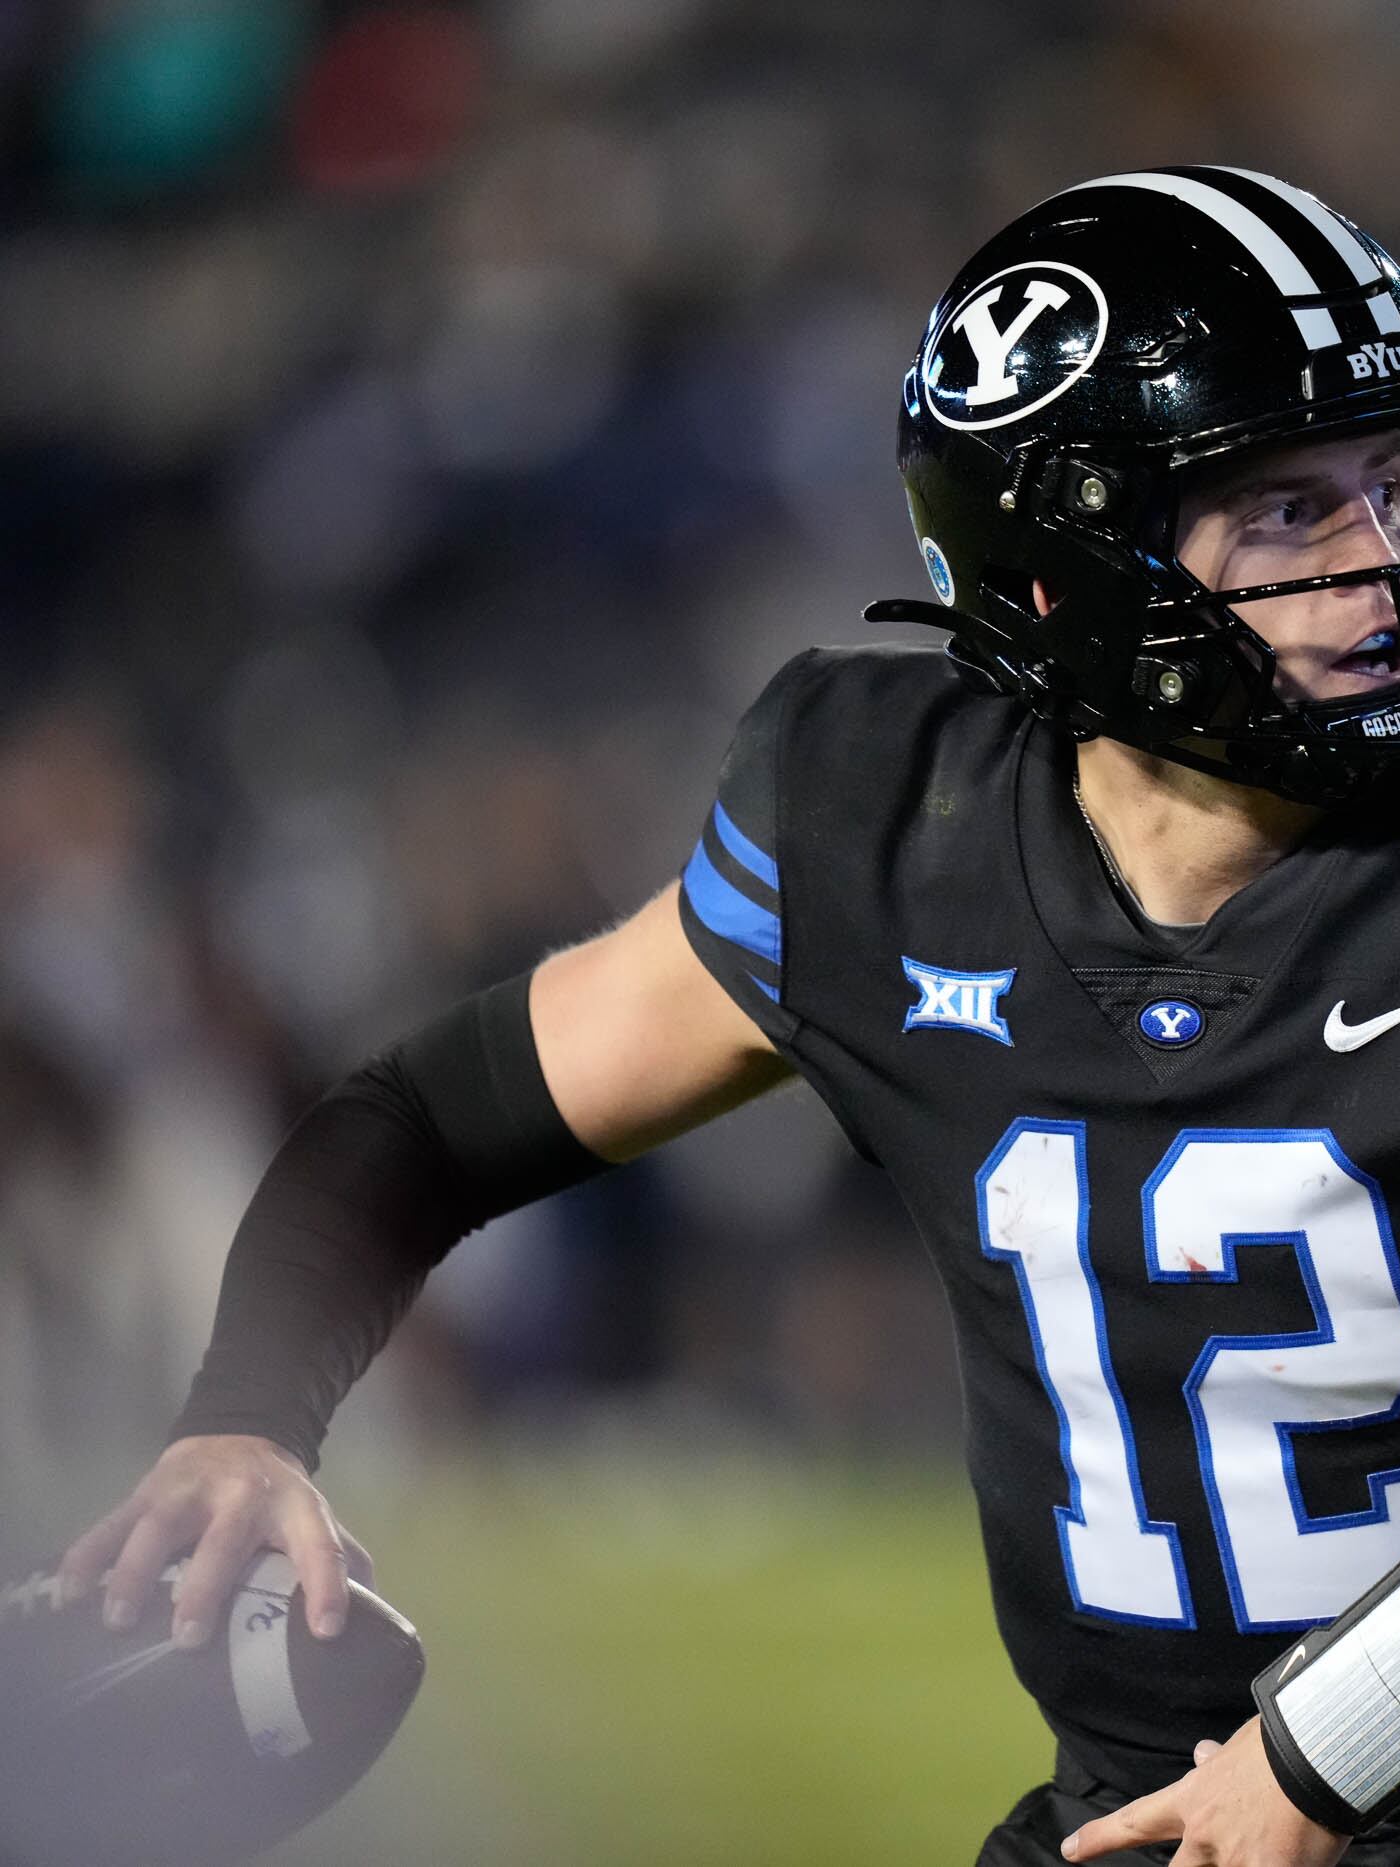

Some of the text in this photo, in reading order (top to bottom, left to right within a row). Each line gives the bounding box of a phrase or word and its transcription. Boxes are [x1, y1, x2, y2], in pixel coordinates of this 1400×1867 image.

[952, 280, 1071, 406] Y
[1361, 716, 1387, 737] GO
[908, 965, 1008, 1036] XII
[1150, 1007, 1192, 1038] Y
